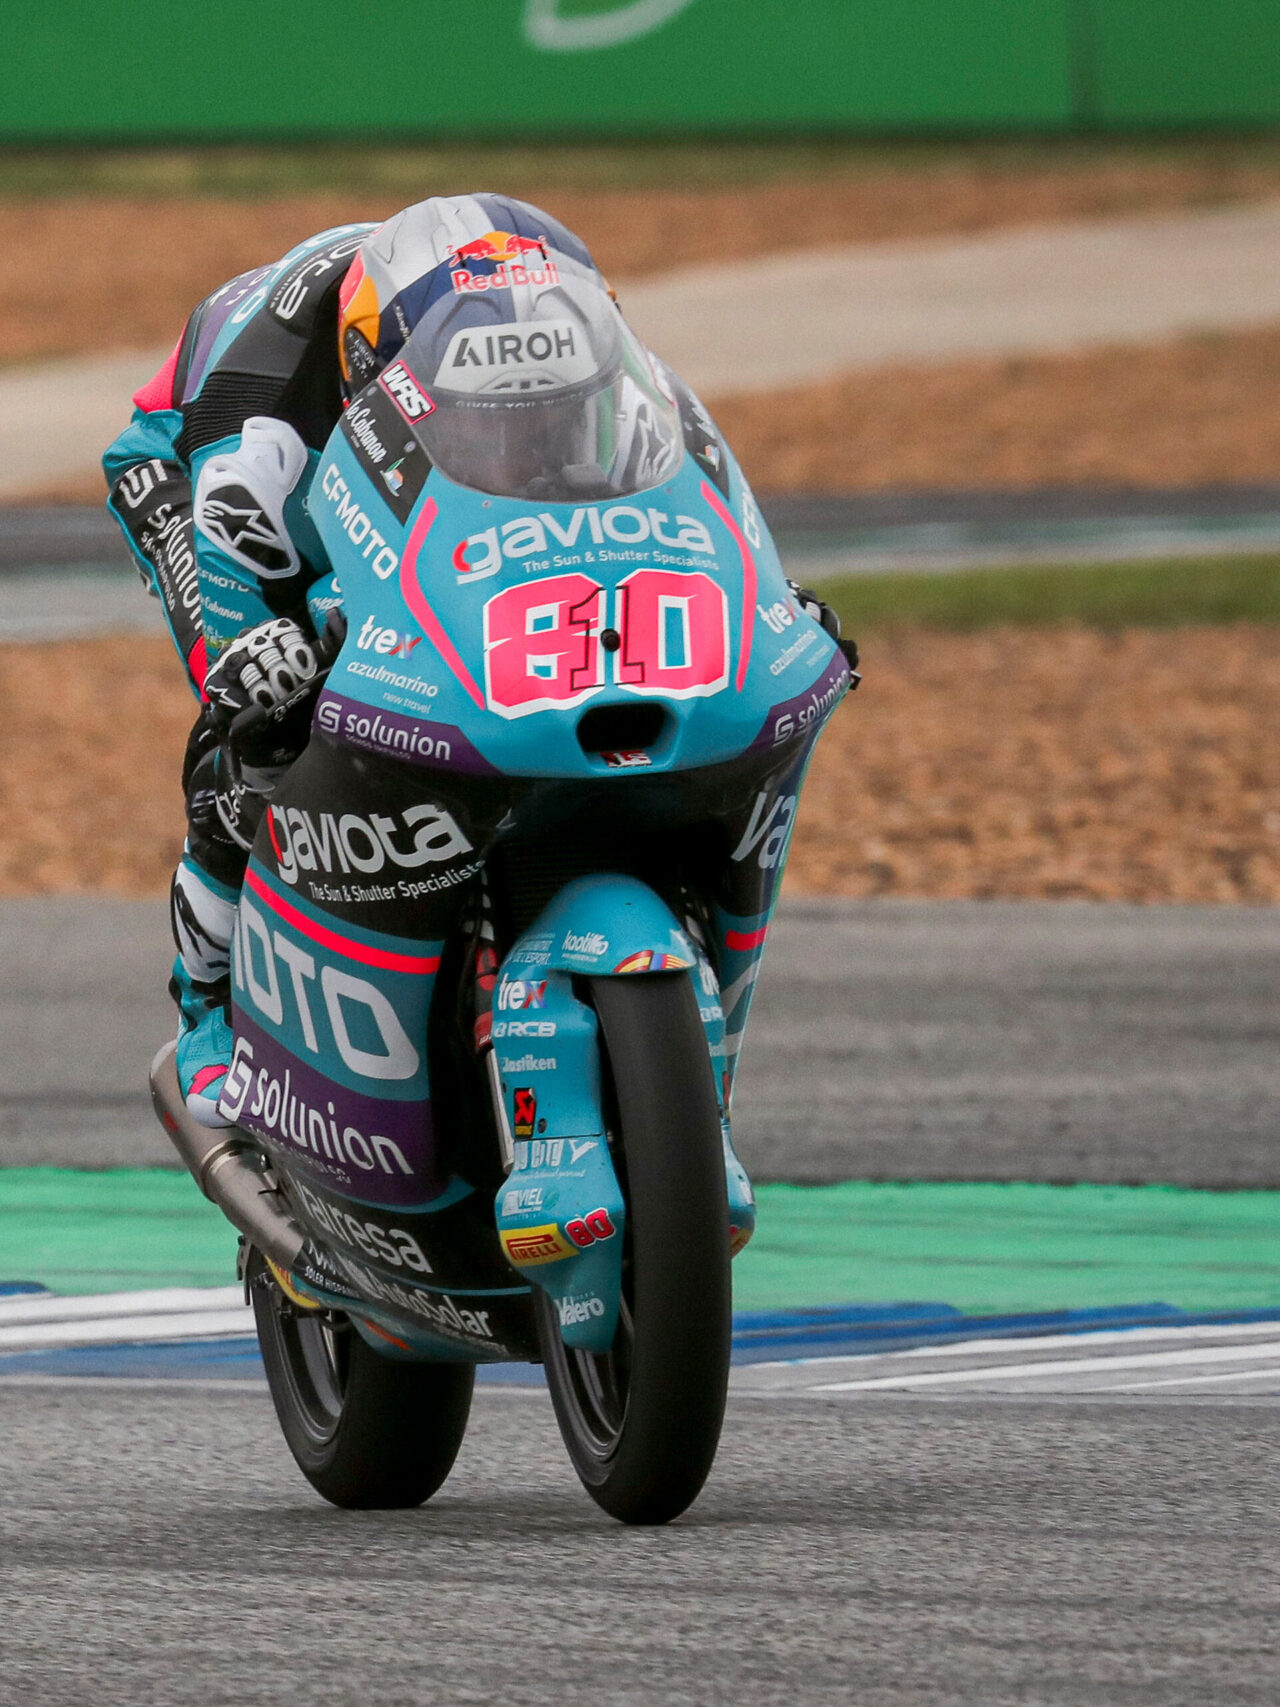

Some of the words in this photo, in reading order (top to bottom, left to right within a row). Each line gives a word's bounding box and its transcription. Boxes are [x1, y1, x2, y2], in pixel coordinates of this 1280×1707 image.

[451, 264, 510, 294] Red
[512, 263, 561, 287] Bull
[452, 328, 576, 368] AIROH
[381, 364, 432, 417] WRS
[350, 407, 387, 464] Cabanon
[322, 463, 399, 580] CFMOTO
[451, 506, 716, 585] gaviota
[523, 559, 550, 574] The
[553, 554, 581, 568] Sun
[585, 551, 596, 563] &
[599, 549, 650, 563] Shutter
[653, 550, 720, 571] Specialists
[356, 614, 422, 660] trex
[346, 661, 439, 697] azulmarino
[344, 713, 451, 761] solunion
[266, 803, 475, 885] gaviota
[308, 881, 325, 900] The
[325, 883, 342, 901] Sun
[350, 885, 396, 902] Shutter
[397, 859, 486, 900] Specialists
[234, 894, 420, 1080] OTO
[498, 973, 548, 1011] trex
[250, 1067, 415, 1175] solunion
[506, 1233, 562, 1261] PIRELLI
[553, 1296, 605, 1327] Valero
